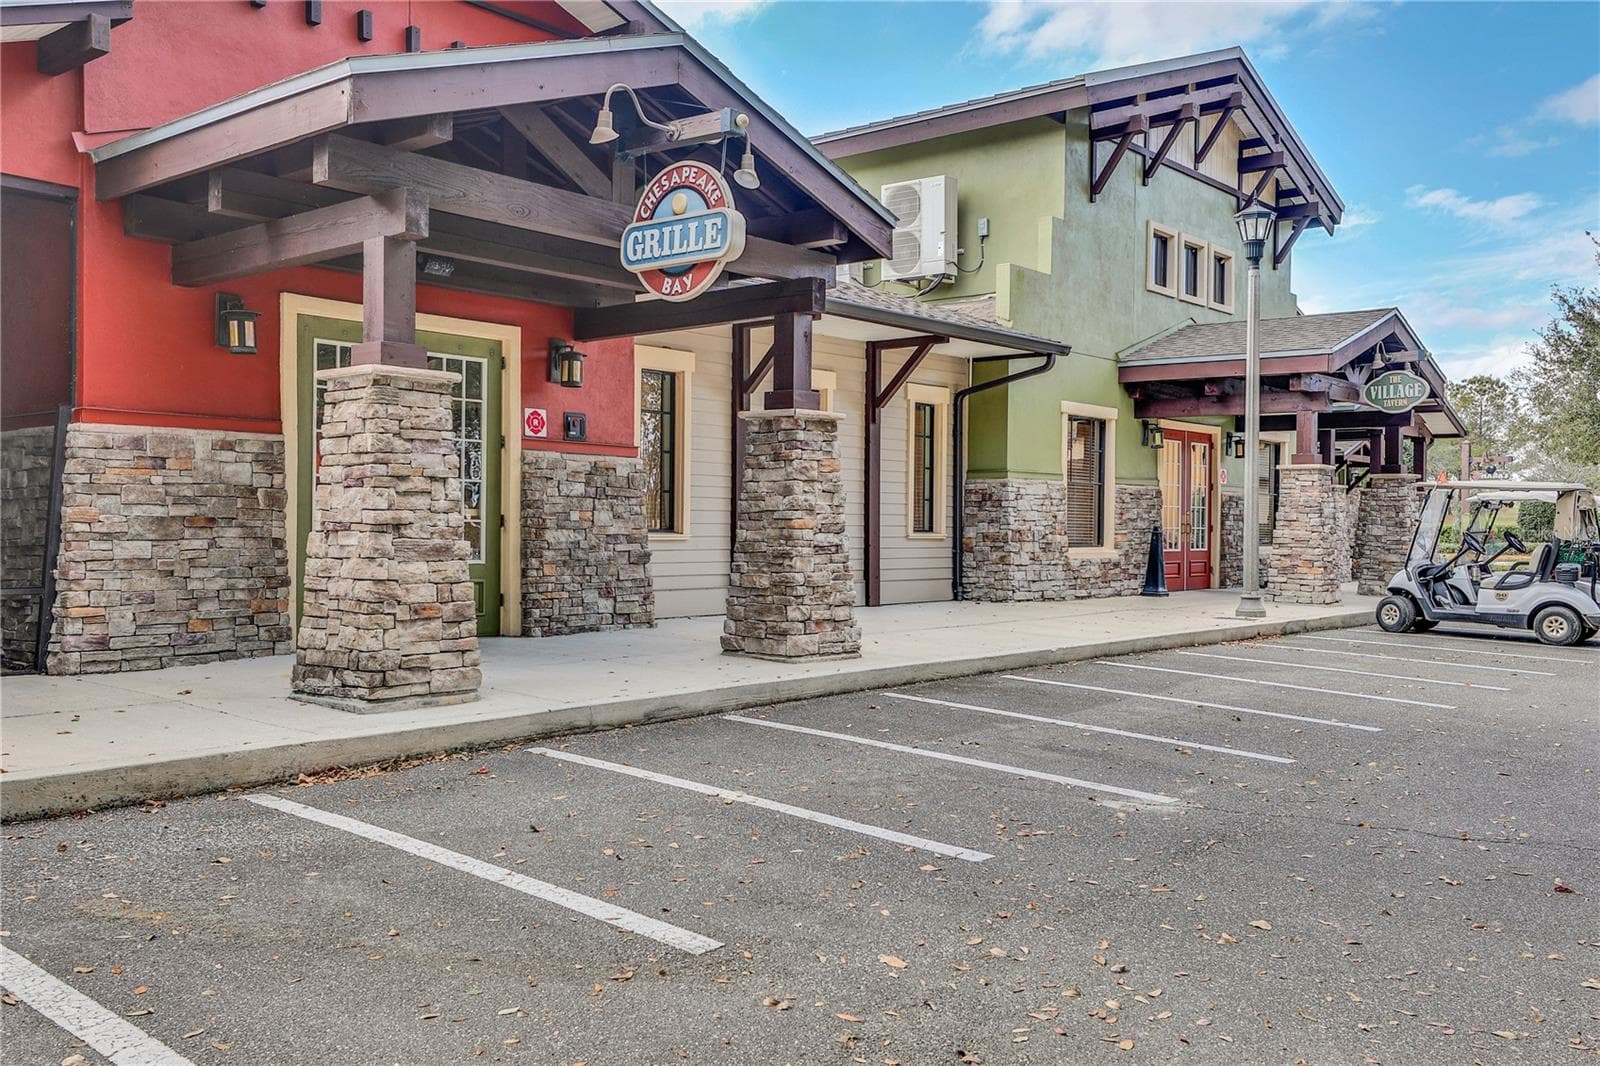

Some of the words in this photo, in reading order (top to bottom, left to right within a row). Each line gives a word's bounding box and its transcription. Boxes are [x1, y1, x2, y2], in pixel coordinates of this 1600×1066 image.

[640, 167, 722, 219] CHESAPEAKE
[626, 217, 722, 261] GRILLE
[661, 273, 693, 294] BAY
[1389, 376, 1402, 384] THE
[1370, 383, 1422, 400] VILLAGE
[1383, 398, 1409, 407] TAVERN
